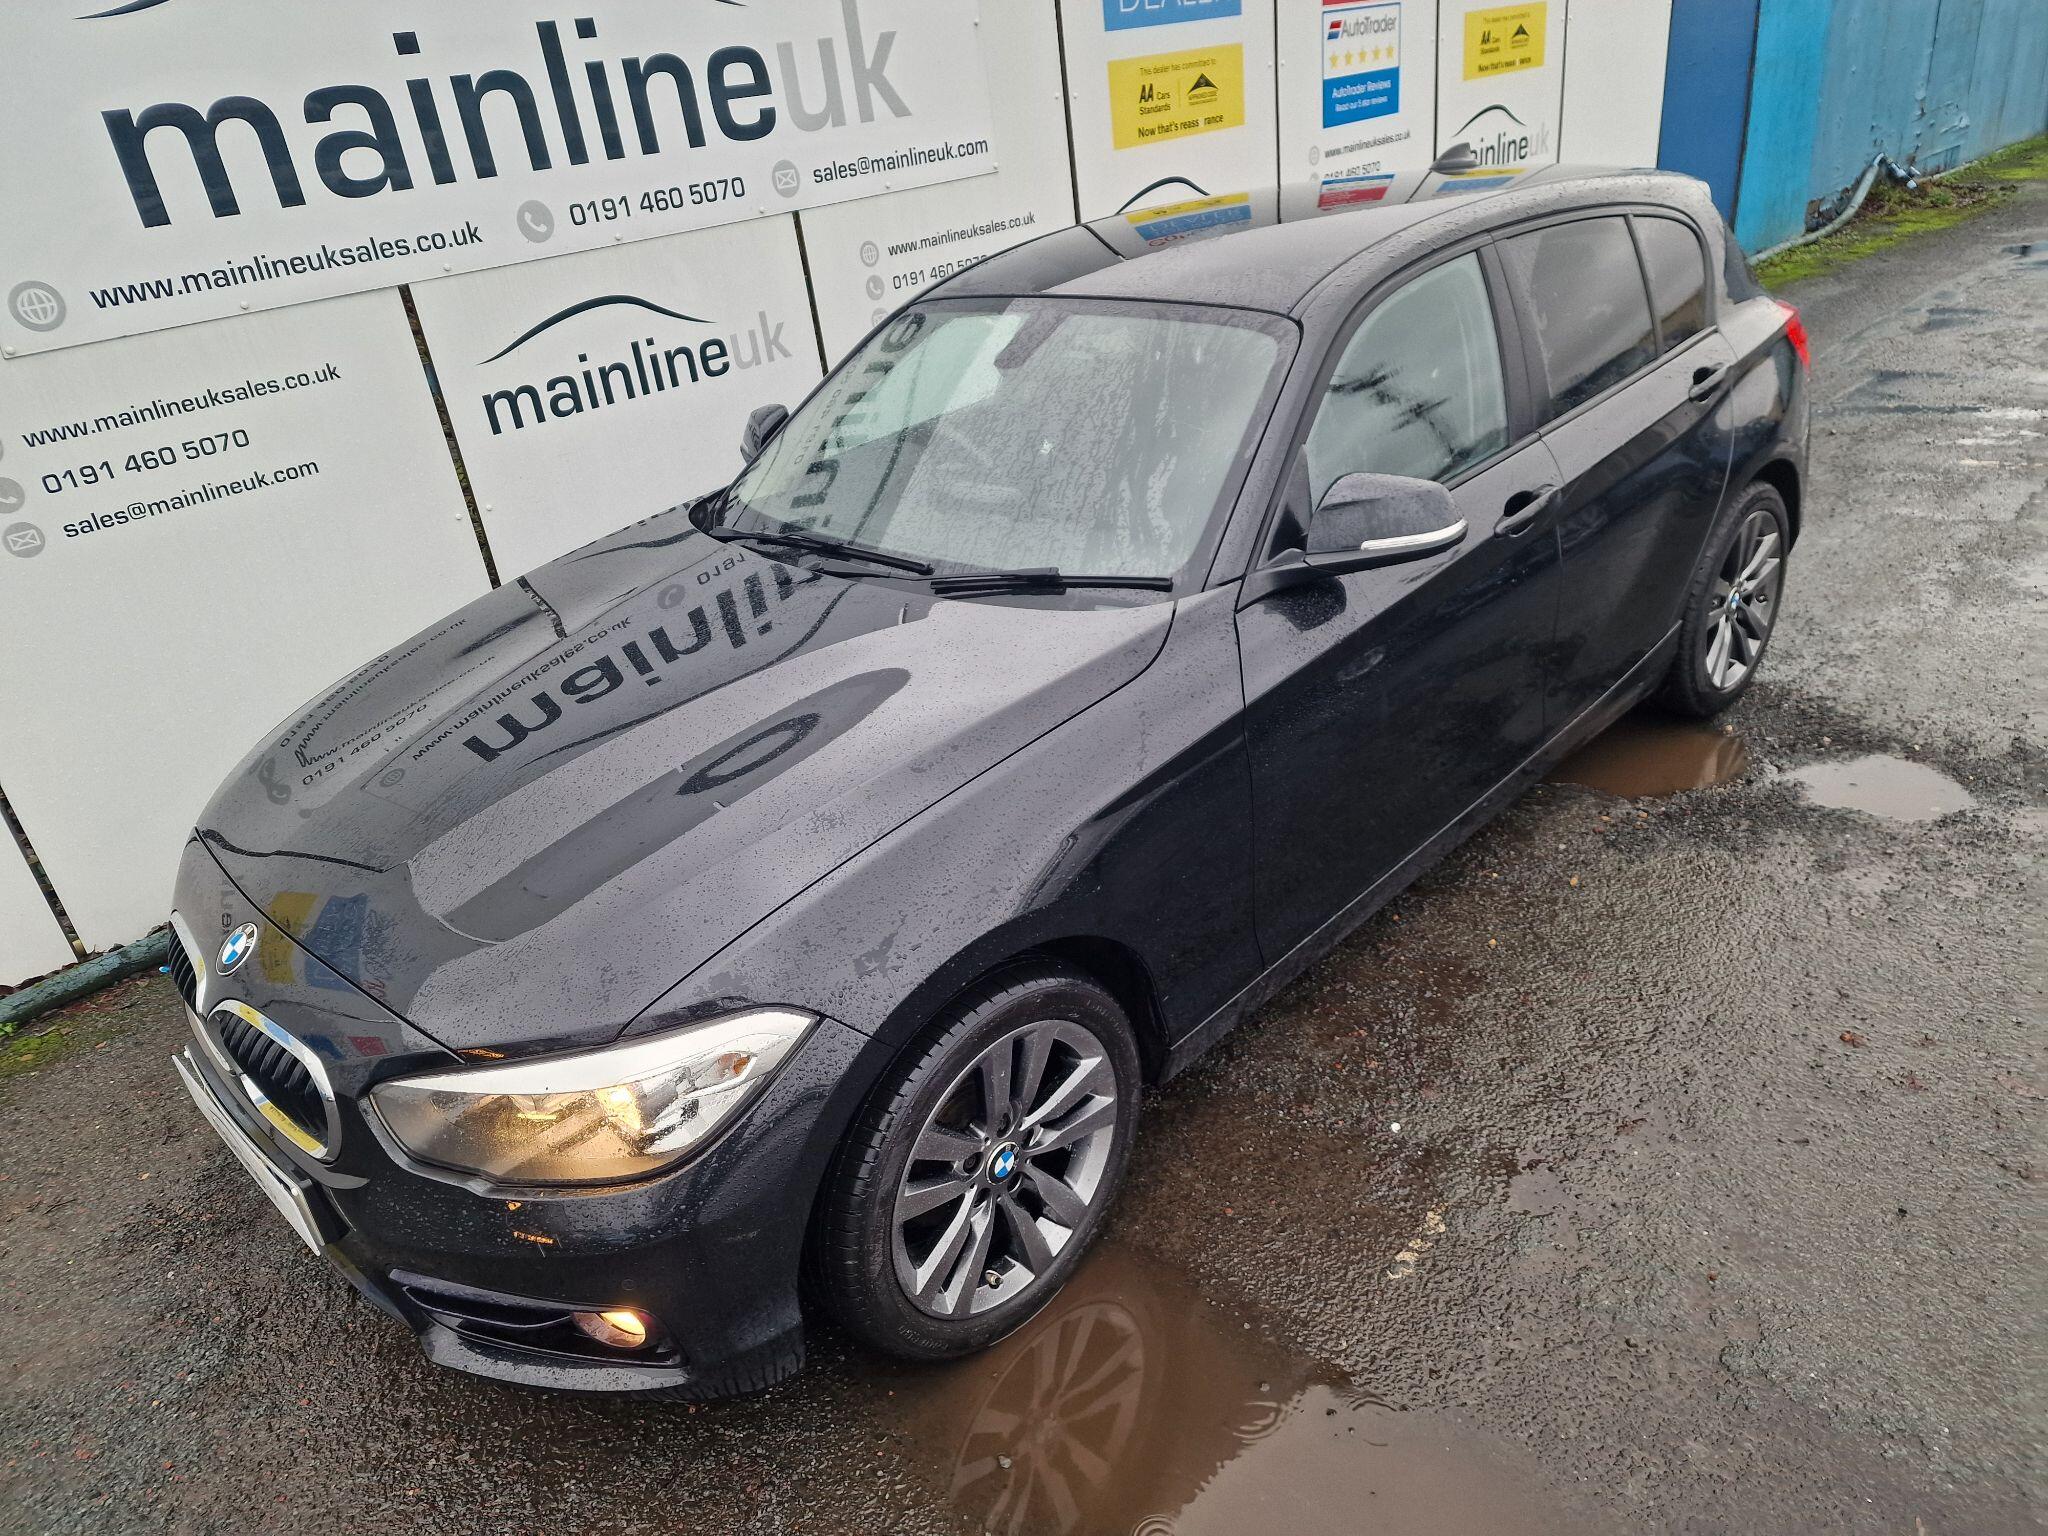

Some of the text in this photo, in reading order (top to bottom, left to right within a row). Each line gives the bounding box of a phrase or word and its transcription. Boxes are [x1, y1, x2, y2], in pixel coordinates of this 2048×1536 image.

[1341, 14, 1397, 38] AutoTrader
[101, 0, 912, 229] mainlineuk
[1139, 83, 1171, 104] AA Cars
[1137, 125, 1157, 138] Now
[812, 137, 989, 184] sales@mainlineuk.com
[569, 176, 746, 226] 0191 460 5070
[888, 211, 1036, 256] www.mainlineuksales.co.uk
[90, 221, 483, 310] www.mainlineuksales.co.uk
[892, 269, 926, 290] 0191
[481, 311, 792, 435] mainlineuk
[22, 362, 341, 449] www.mainlineuksales.co.uk
[41, 428, 250, 495] 0191 460 5070
[62, 458, 320, 539] sales@mainlineuk.com
